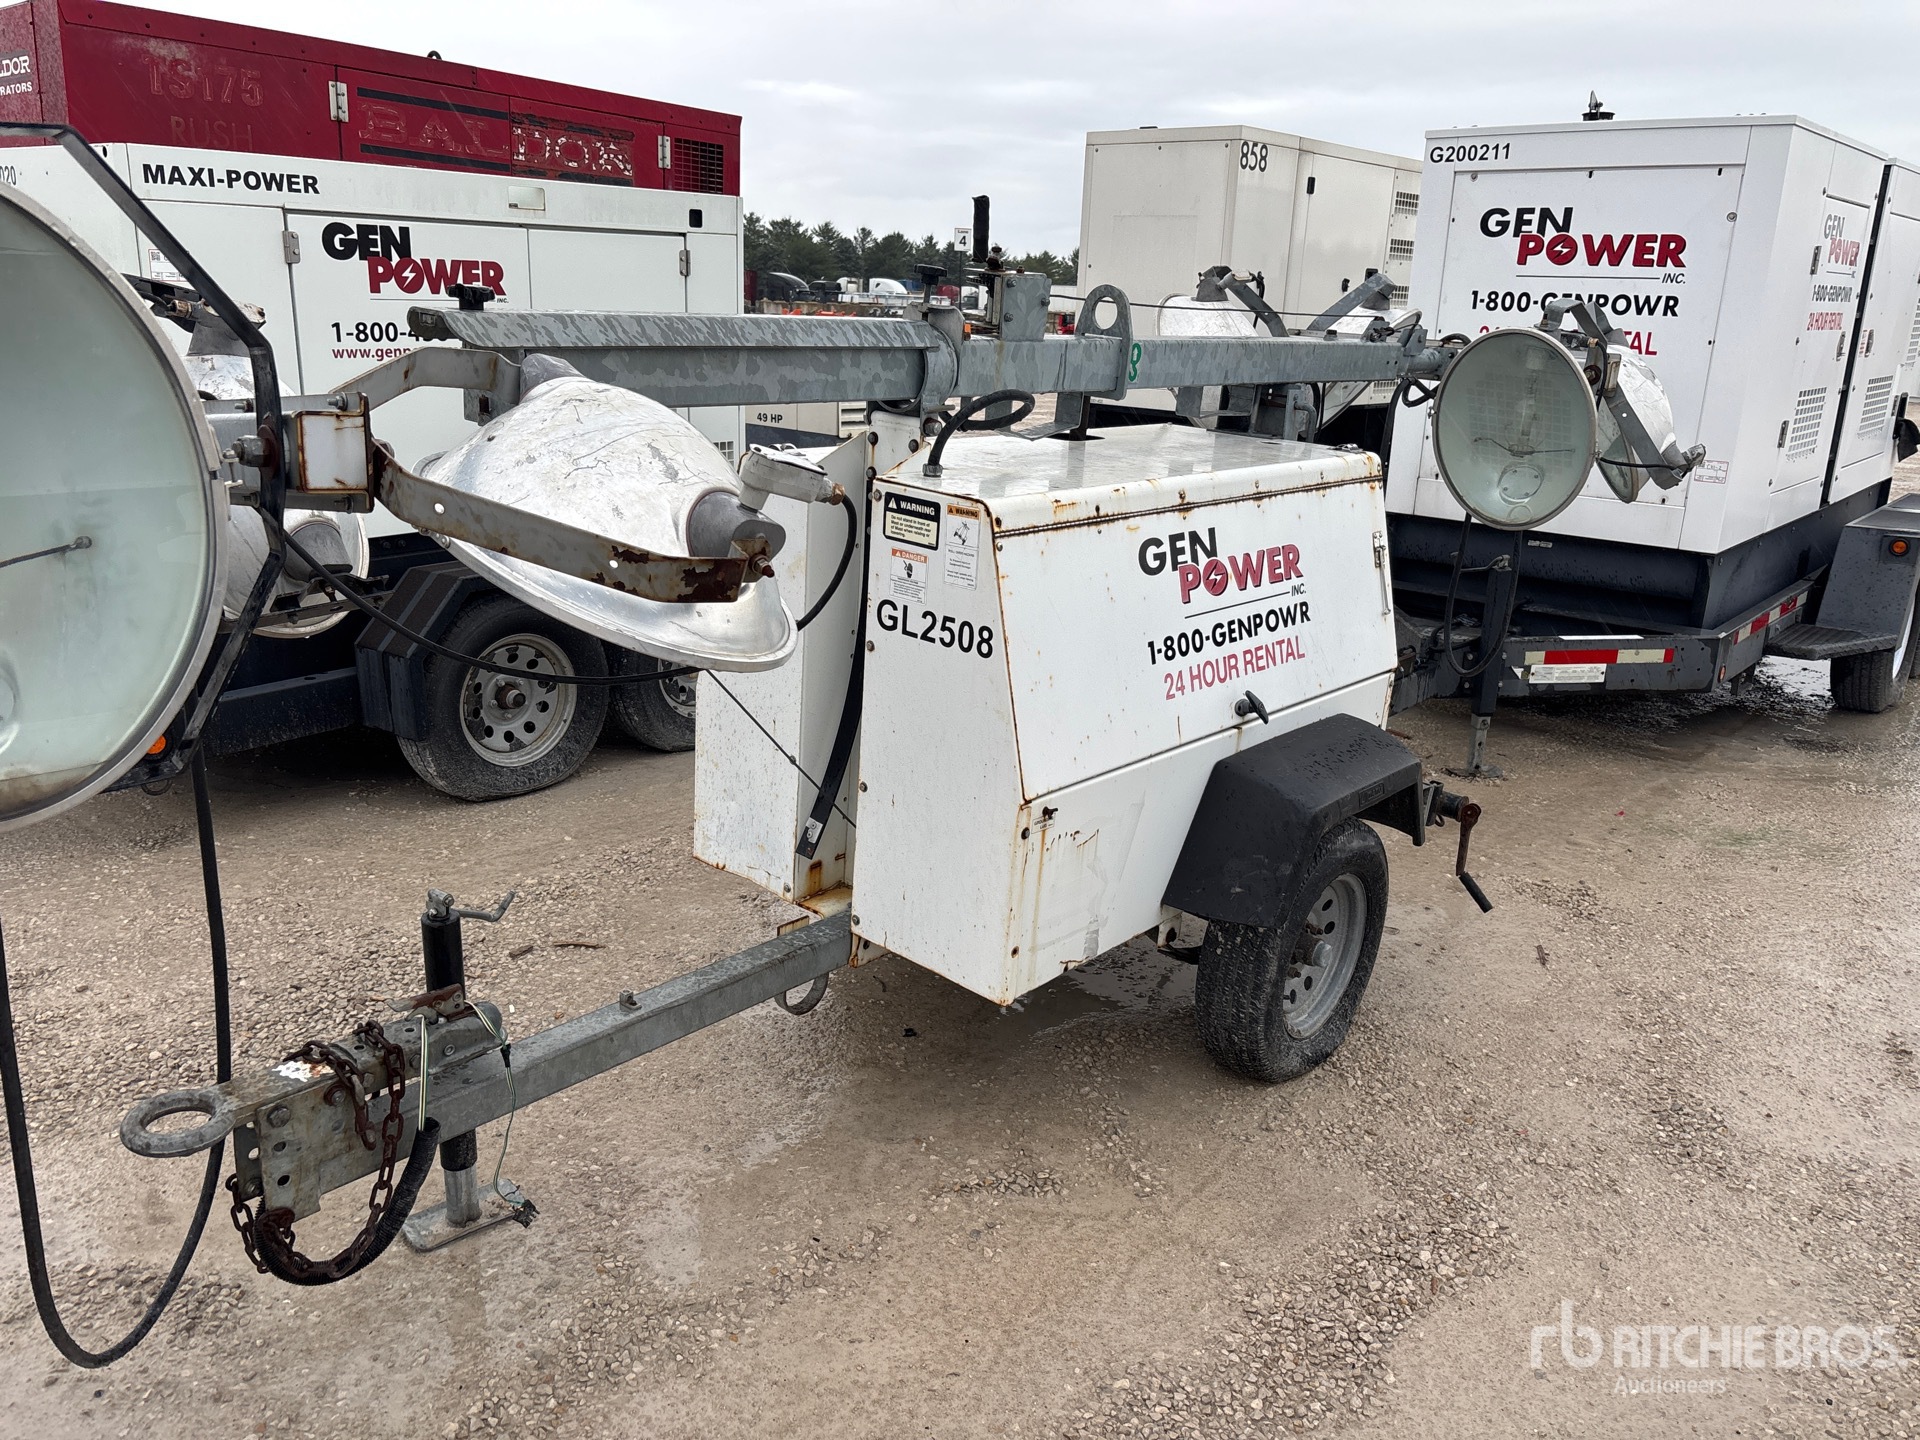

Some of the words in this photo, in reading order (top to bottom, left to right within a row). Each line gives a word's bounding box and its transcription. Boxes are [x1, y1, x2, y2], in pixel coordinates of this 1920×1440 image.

[1240, 141, 1269, 172] 858
[1429, 142, 1511, 164] G200211
[142, 163, 320, 195] MAXI-POWER
[1480, 207, 1574, 238] GEN
[1824, 214, 1845, 240] GEN
[322, 222, 411, 261] GEN
[959, 235, 967, 247] 4
[1516, 234, 1687, 268] POWER
[1828, 236, 1860, 267] POWER
[367, 256, 506, 296] POWER
[1662, 273, 1686, 285] INC.
[757, 412, 768, 423] 49
[770, 413, 783, 424] HP
[900, 500, 935, 516] WARNING
[902, 551, 925, 563] DANGER
[1138, 527, 1218, 576] GEN
[1178, 543, 1304, 605] POWER
[1291, 583, 1307, 597] INC.
[876, 598, 994, 659] GL2508
[1147, 600, 1312, 666] 1-800-GENPOWR
[1164, 670, 1186, 701] 24
[1189, 653, 1240, 692] HOUR
[1243, 636, 1306, 676] RENTAL
